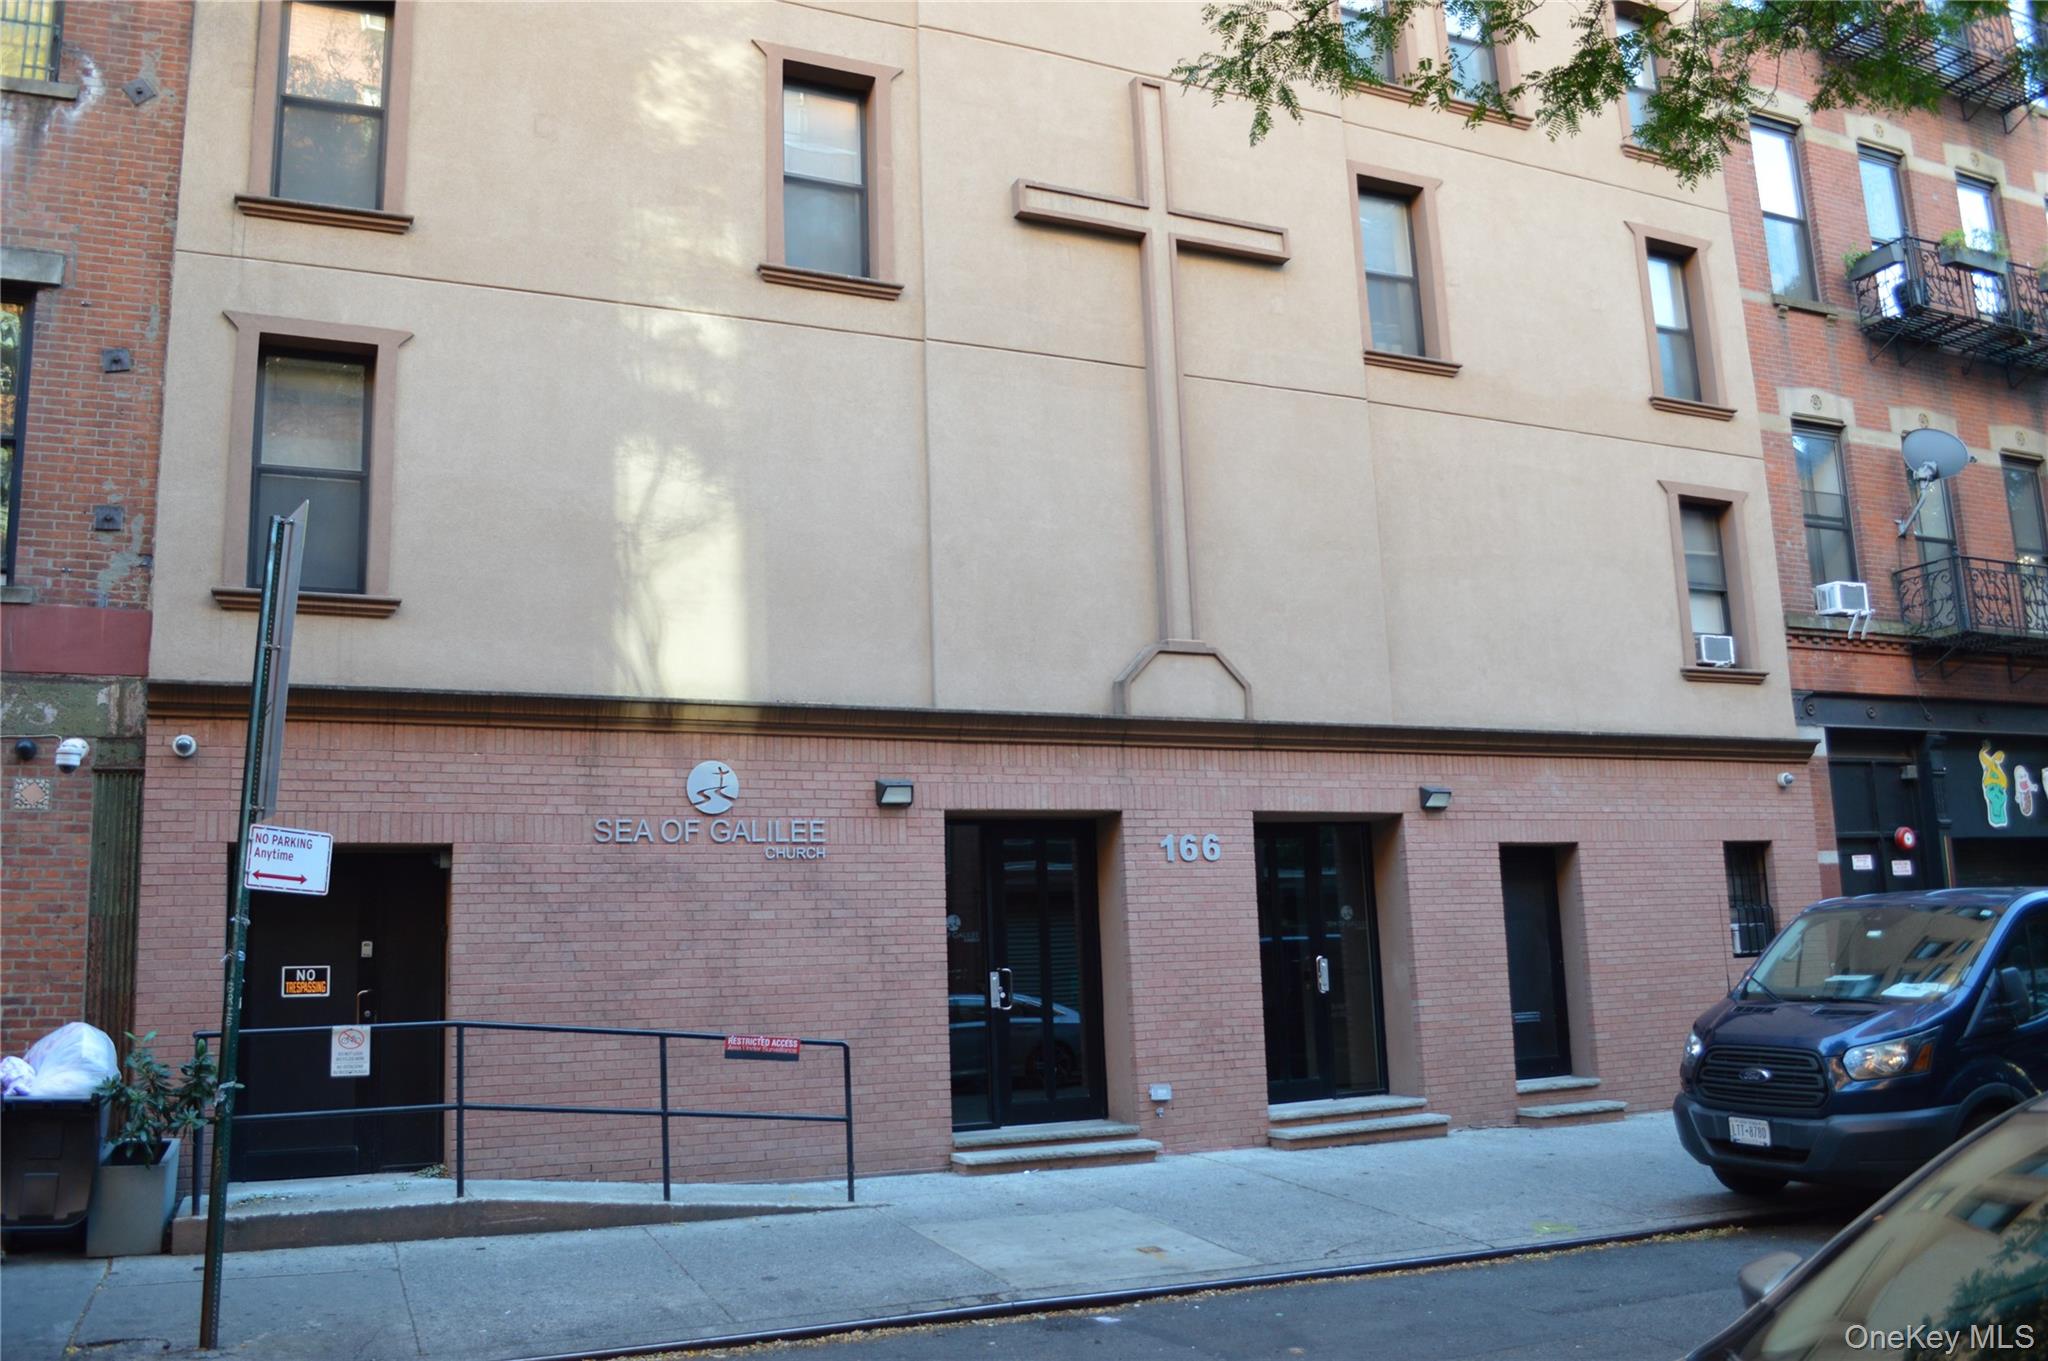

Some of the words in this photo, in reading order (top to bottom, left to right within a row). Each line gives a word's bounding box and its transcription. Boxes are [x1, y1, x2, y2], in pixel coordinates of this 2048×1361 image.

[594, 818, 654, 843] SEA
[661, 818, 701, 843] OF
[710, 818, 827, 844] GALILEE
[255, 833, 269, 845] NO
[271, 834, 313, 850] PARKING
[1160, 833, 1221, 863] 166
[254, 847, 294, 861] Anytime
[765, 847, 826, 859] CHURCH
[296, 969, 316, 982] NO
[286, 981, 327, 993] TRESPASSING
[727, 1036, 770, 1047] RESTRICTED
[771, 1039, 798, 1048] ACCESS
